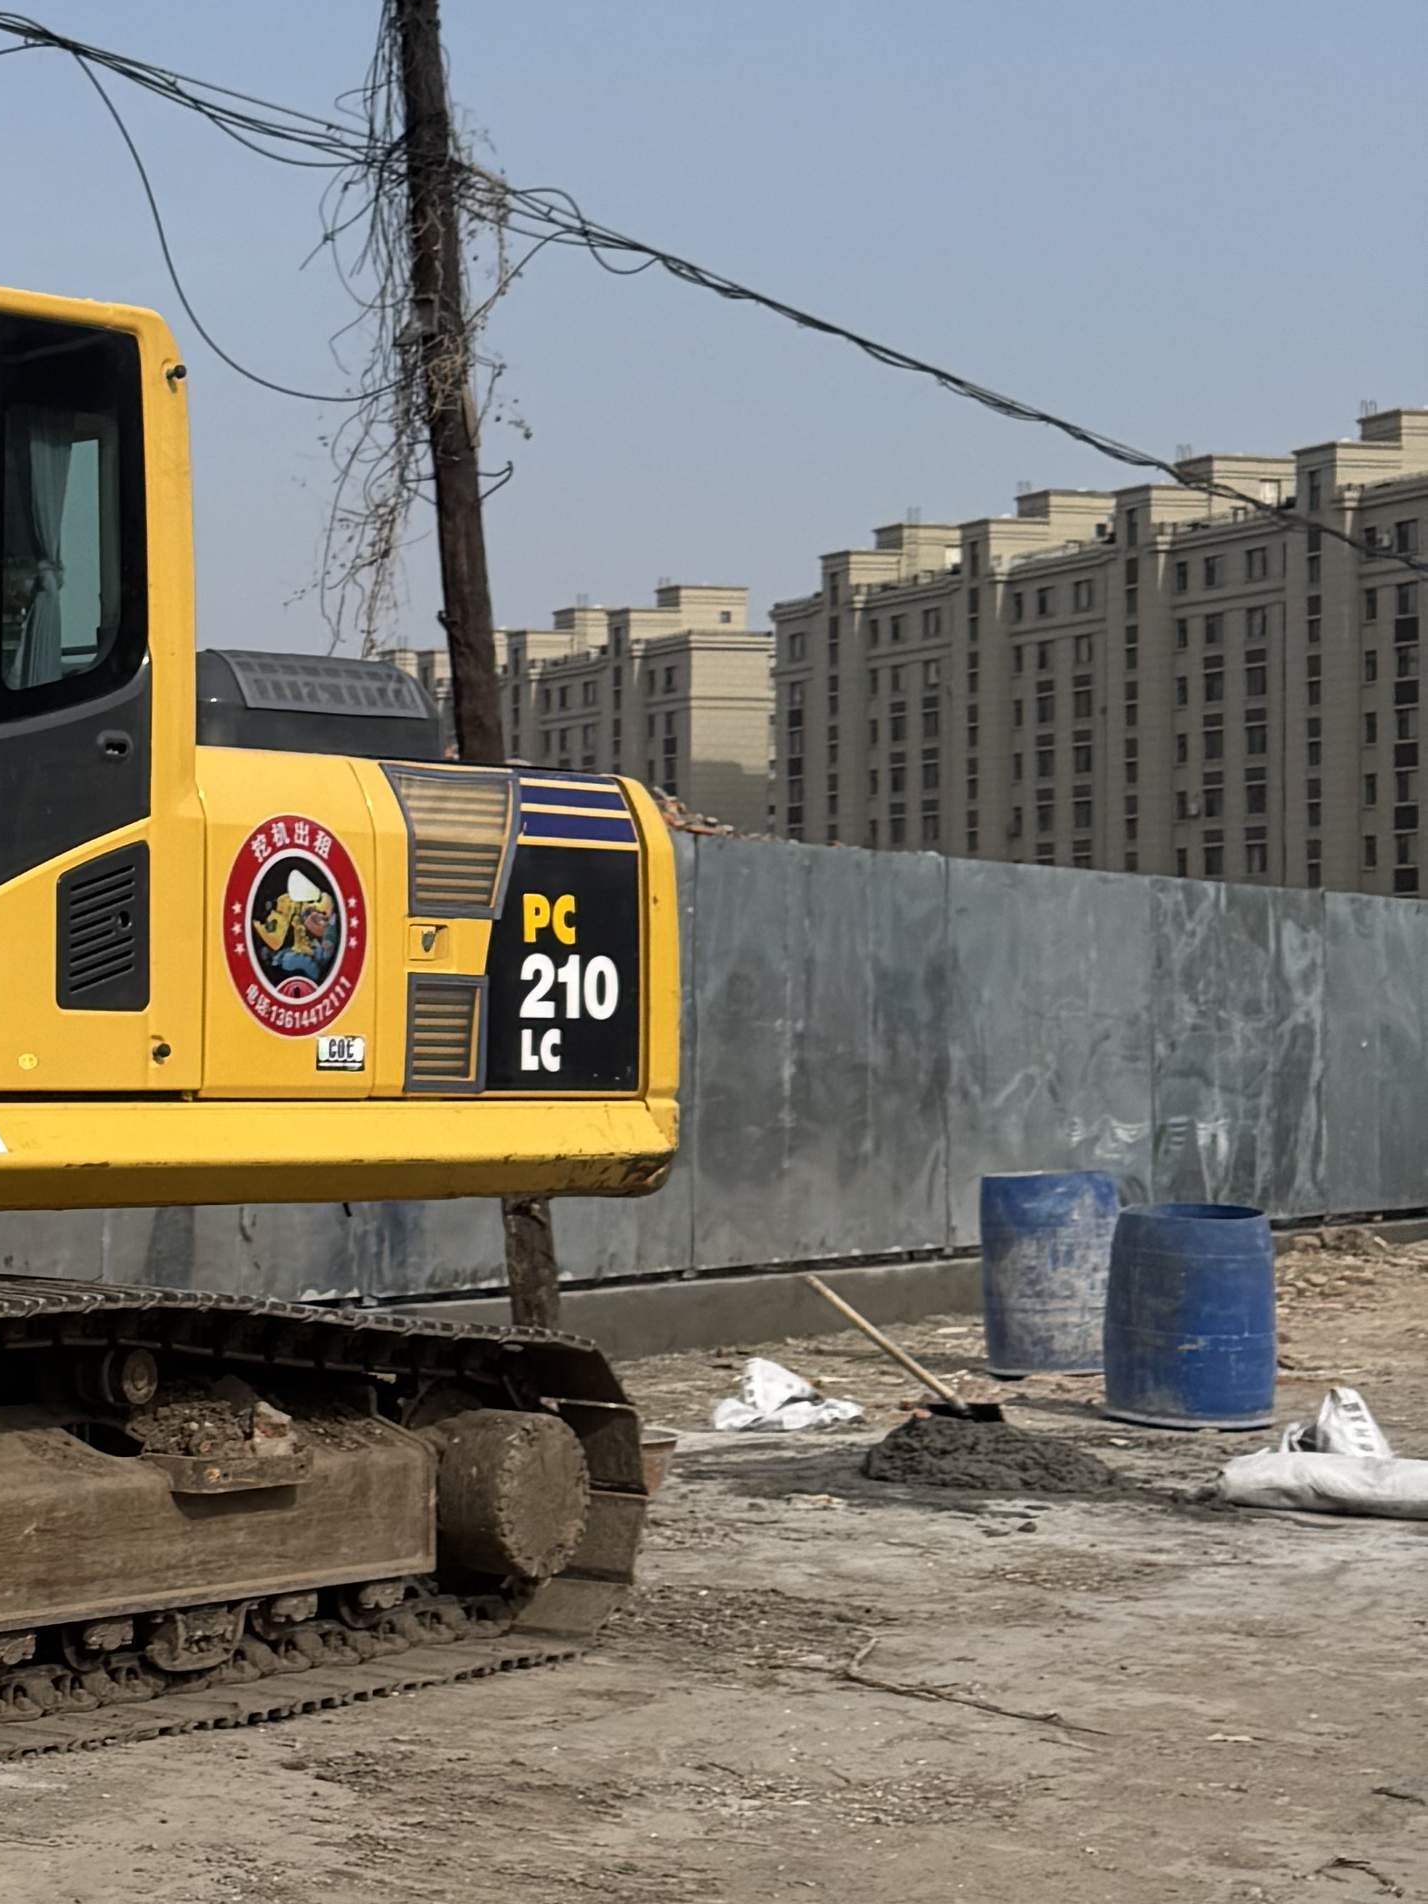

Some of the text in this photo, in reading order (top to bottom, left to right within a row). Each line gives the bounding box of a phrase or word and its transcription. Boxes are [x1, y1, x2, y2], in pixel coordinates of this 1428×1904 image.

[250, 820, 332, 863] 挖机出租
[523, 893, 576, 945] PC
[519, 953, 619, 1020] 210
[521, 1028, 562, 1072] LC
